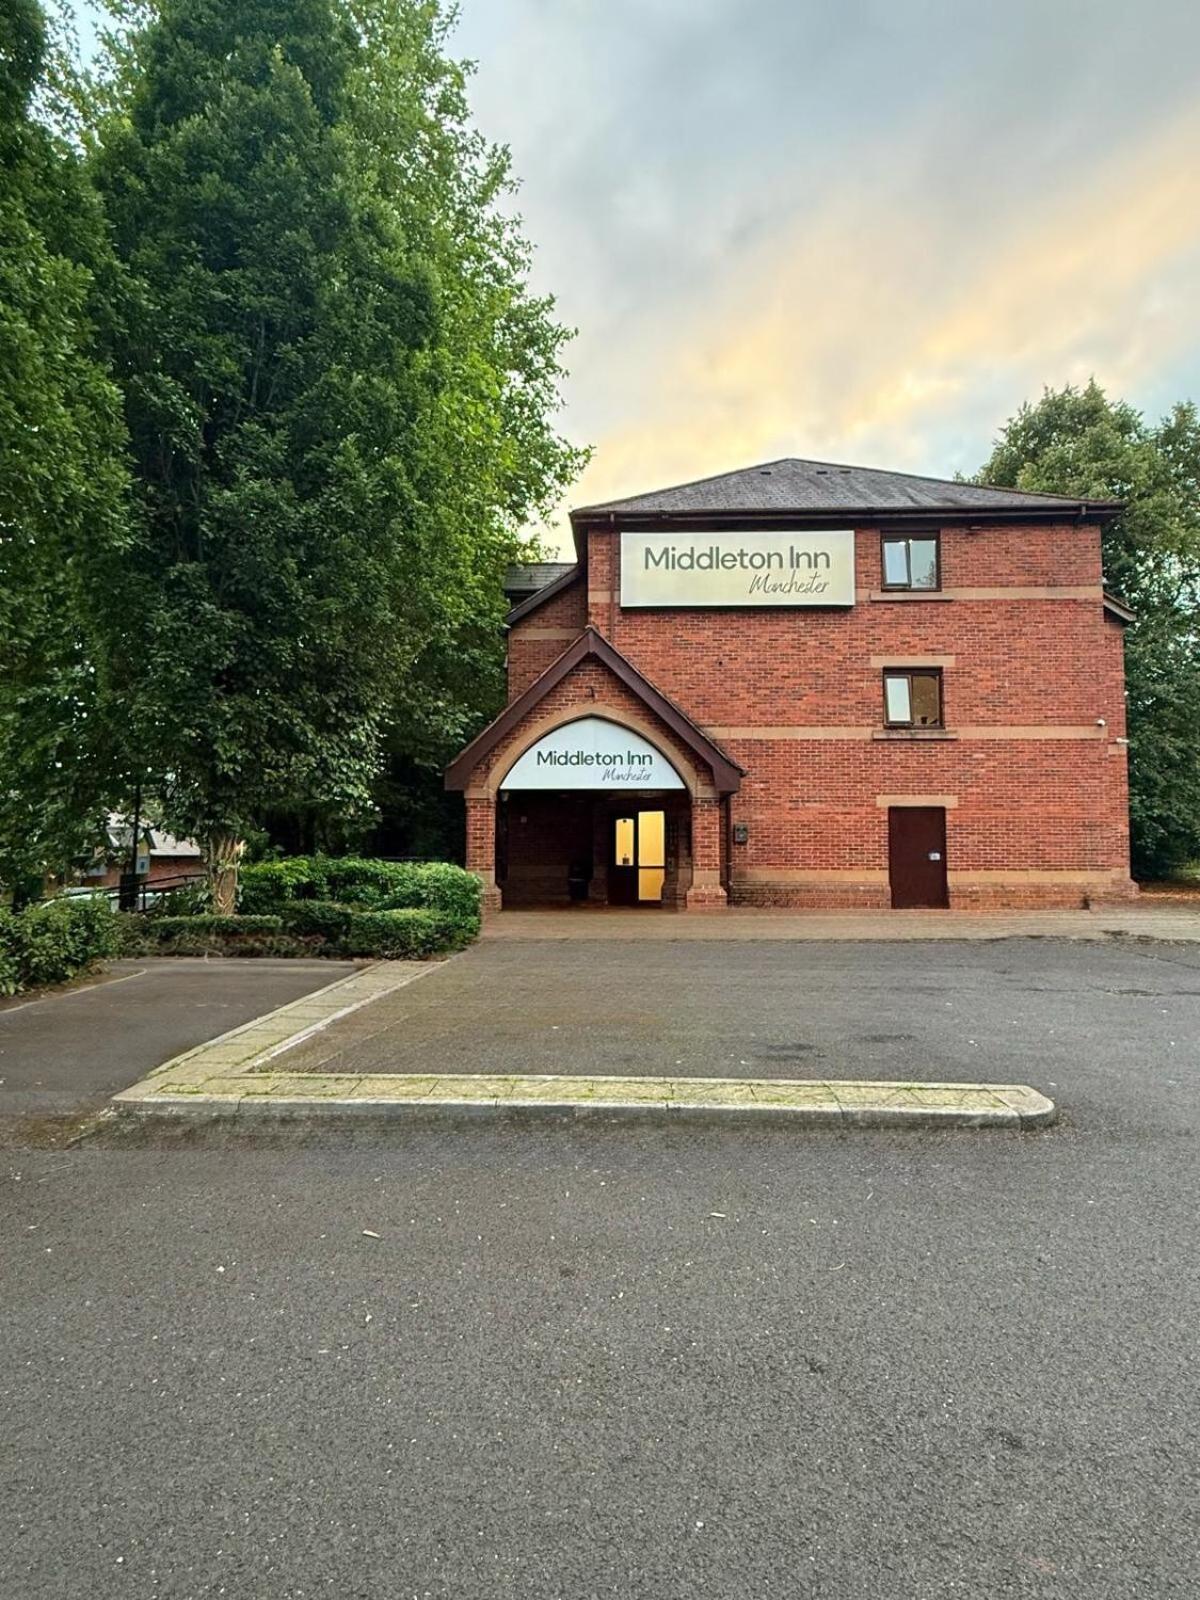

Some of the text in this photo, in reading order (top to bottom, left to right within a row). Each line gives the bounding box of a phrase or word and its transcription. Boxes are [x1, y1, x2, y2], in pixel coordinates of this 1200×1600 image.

[644, 545, 830, 570] Middleton Inn
[749, 570, 830, 594] Manchester
[536, 750, 653, 766] Middleton Inn
